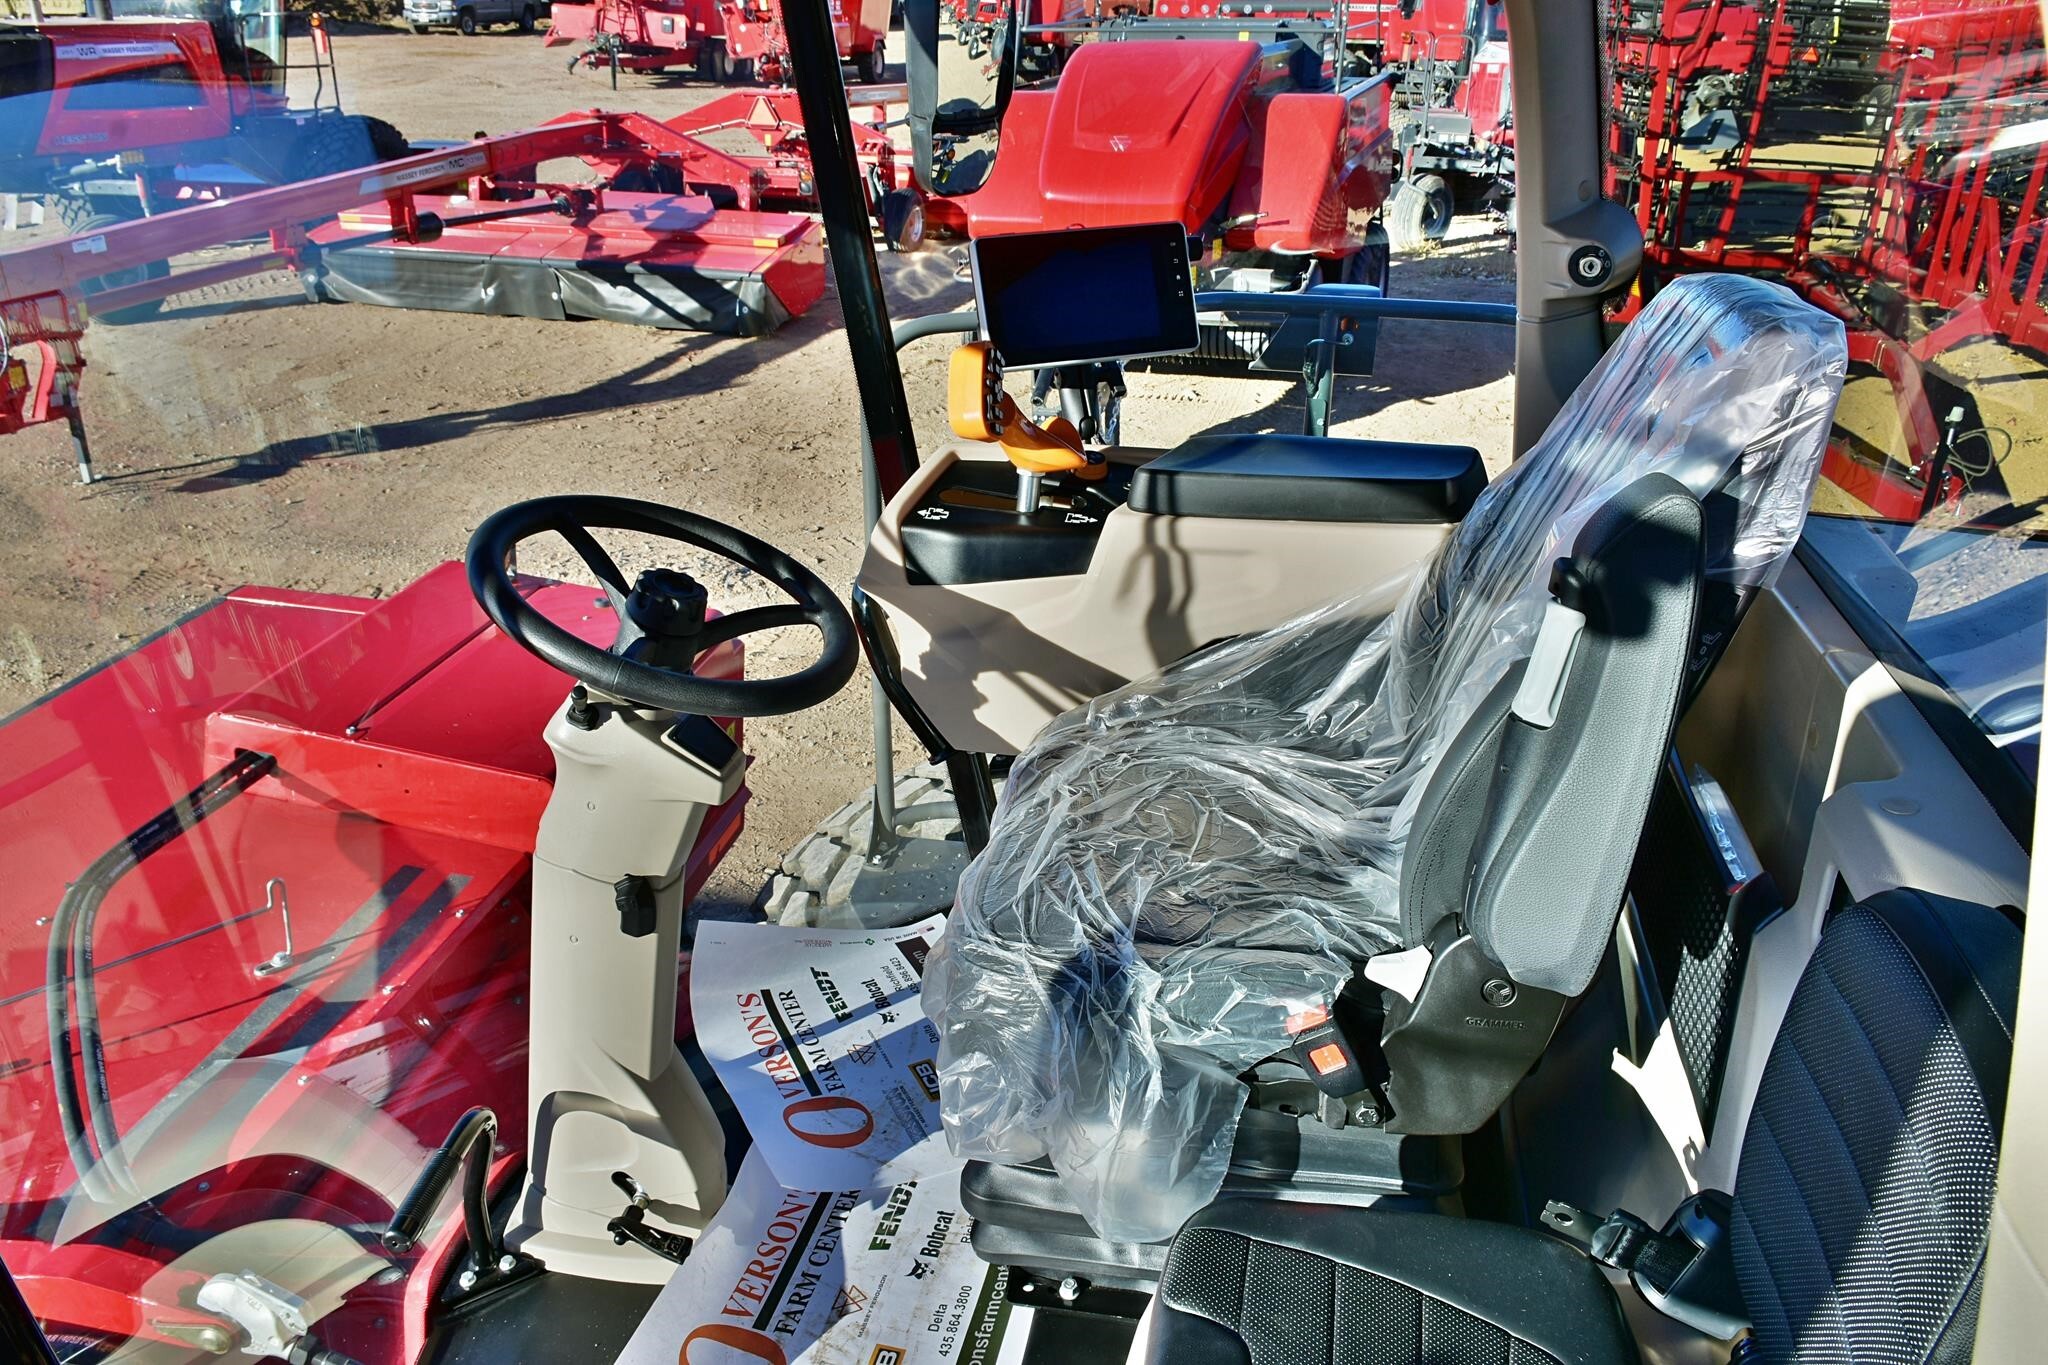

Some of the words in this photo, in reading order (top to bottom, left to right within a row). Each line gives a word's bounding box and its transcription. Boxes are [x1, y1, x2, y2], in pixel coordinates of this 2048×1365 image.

[79, 47, 96, 57] WR
[101, 47, 125, 55] MASSEY
[125, 46, 154, 54] FERGUSON
[395, 171, 418, 181] MASSEY
[418, 165, 445, 177] FERGUSON
[448, 158, 465, 169] MC
[810, 966, 853, 1023] FENDT
[861, 979, 892, 1009] Bobcat
[880, 965, 903, 992] Richfield
[779, 989, 820, 1046] CENTER
[923, 1024, 941, 1044] Delta
[1465, 1016, 1525, 1030] GRAMMER
[808, 1048, 846, 1093] FARM
[920, 1210, 955, 1258] Bobcat
[773, 1272, 822, 1337] FARM
[857, 1308, 873, 1338] MASSEY
[869, 1274, 888, 1309] FERGUSON
[928, 1303, 948, 1333] Delta
[938, 1285, 973, 1357] 435.864.3800
